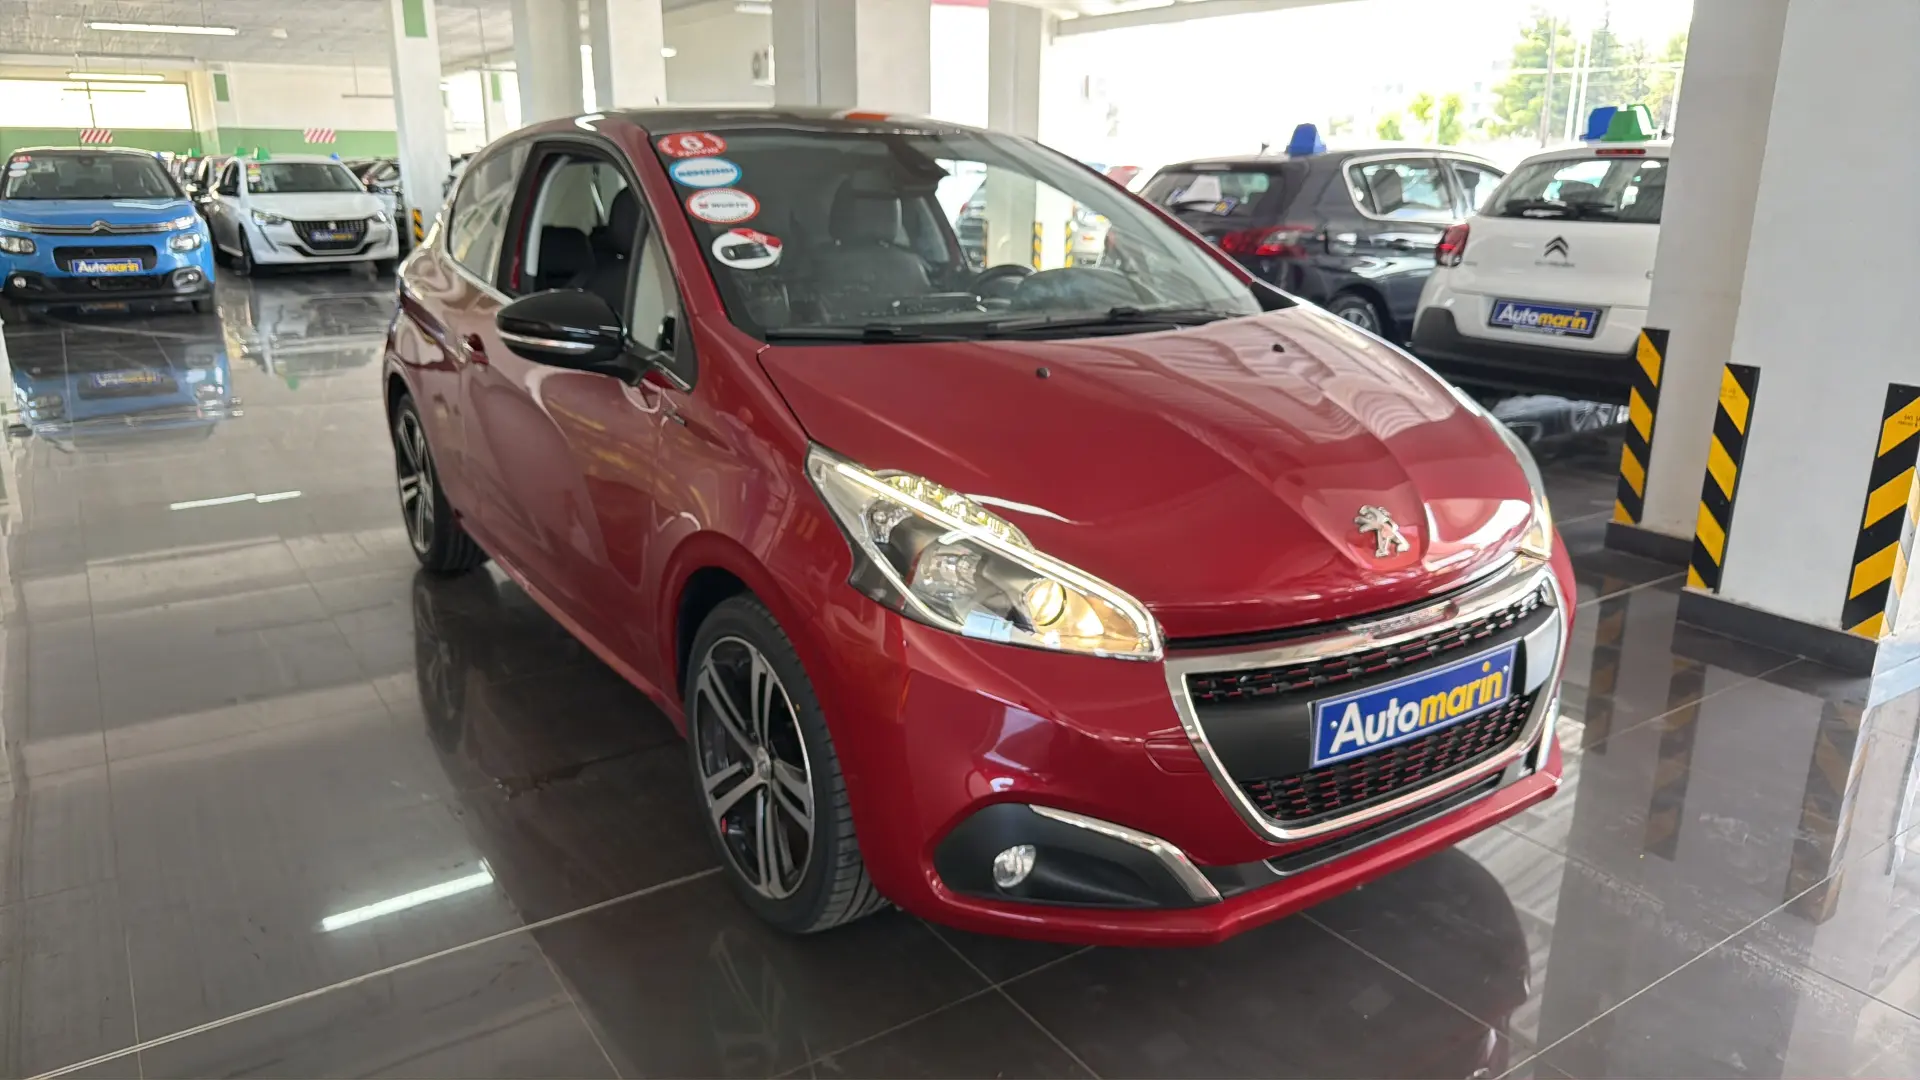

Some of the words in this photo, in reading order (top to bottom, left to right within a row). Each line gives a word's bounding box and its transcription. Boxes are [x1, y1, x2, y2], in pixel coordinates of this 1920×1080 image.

[77, 260, 139, 273] Automarin
[1498, 303, 1588, 330] Automarin
[1329, 660, 1503, 755] Automarin
